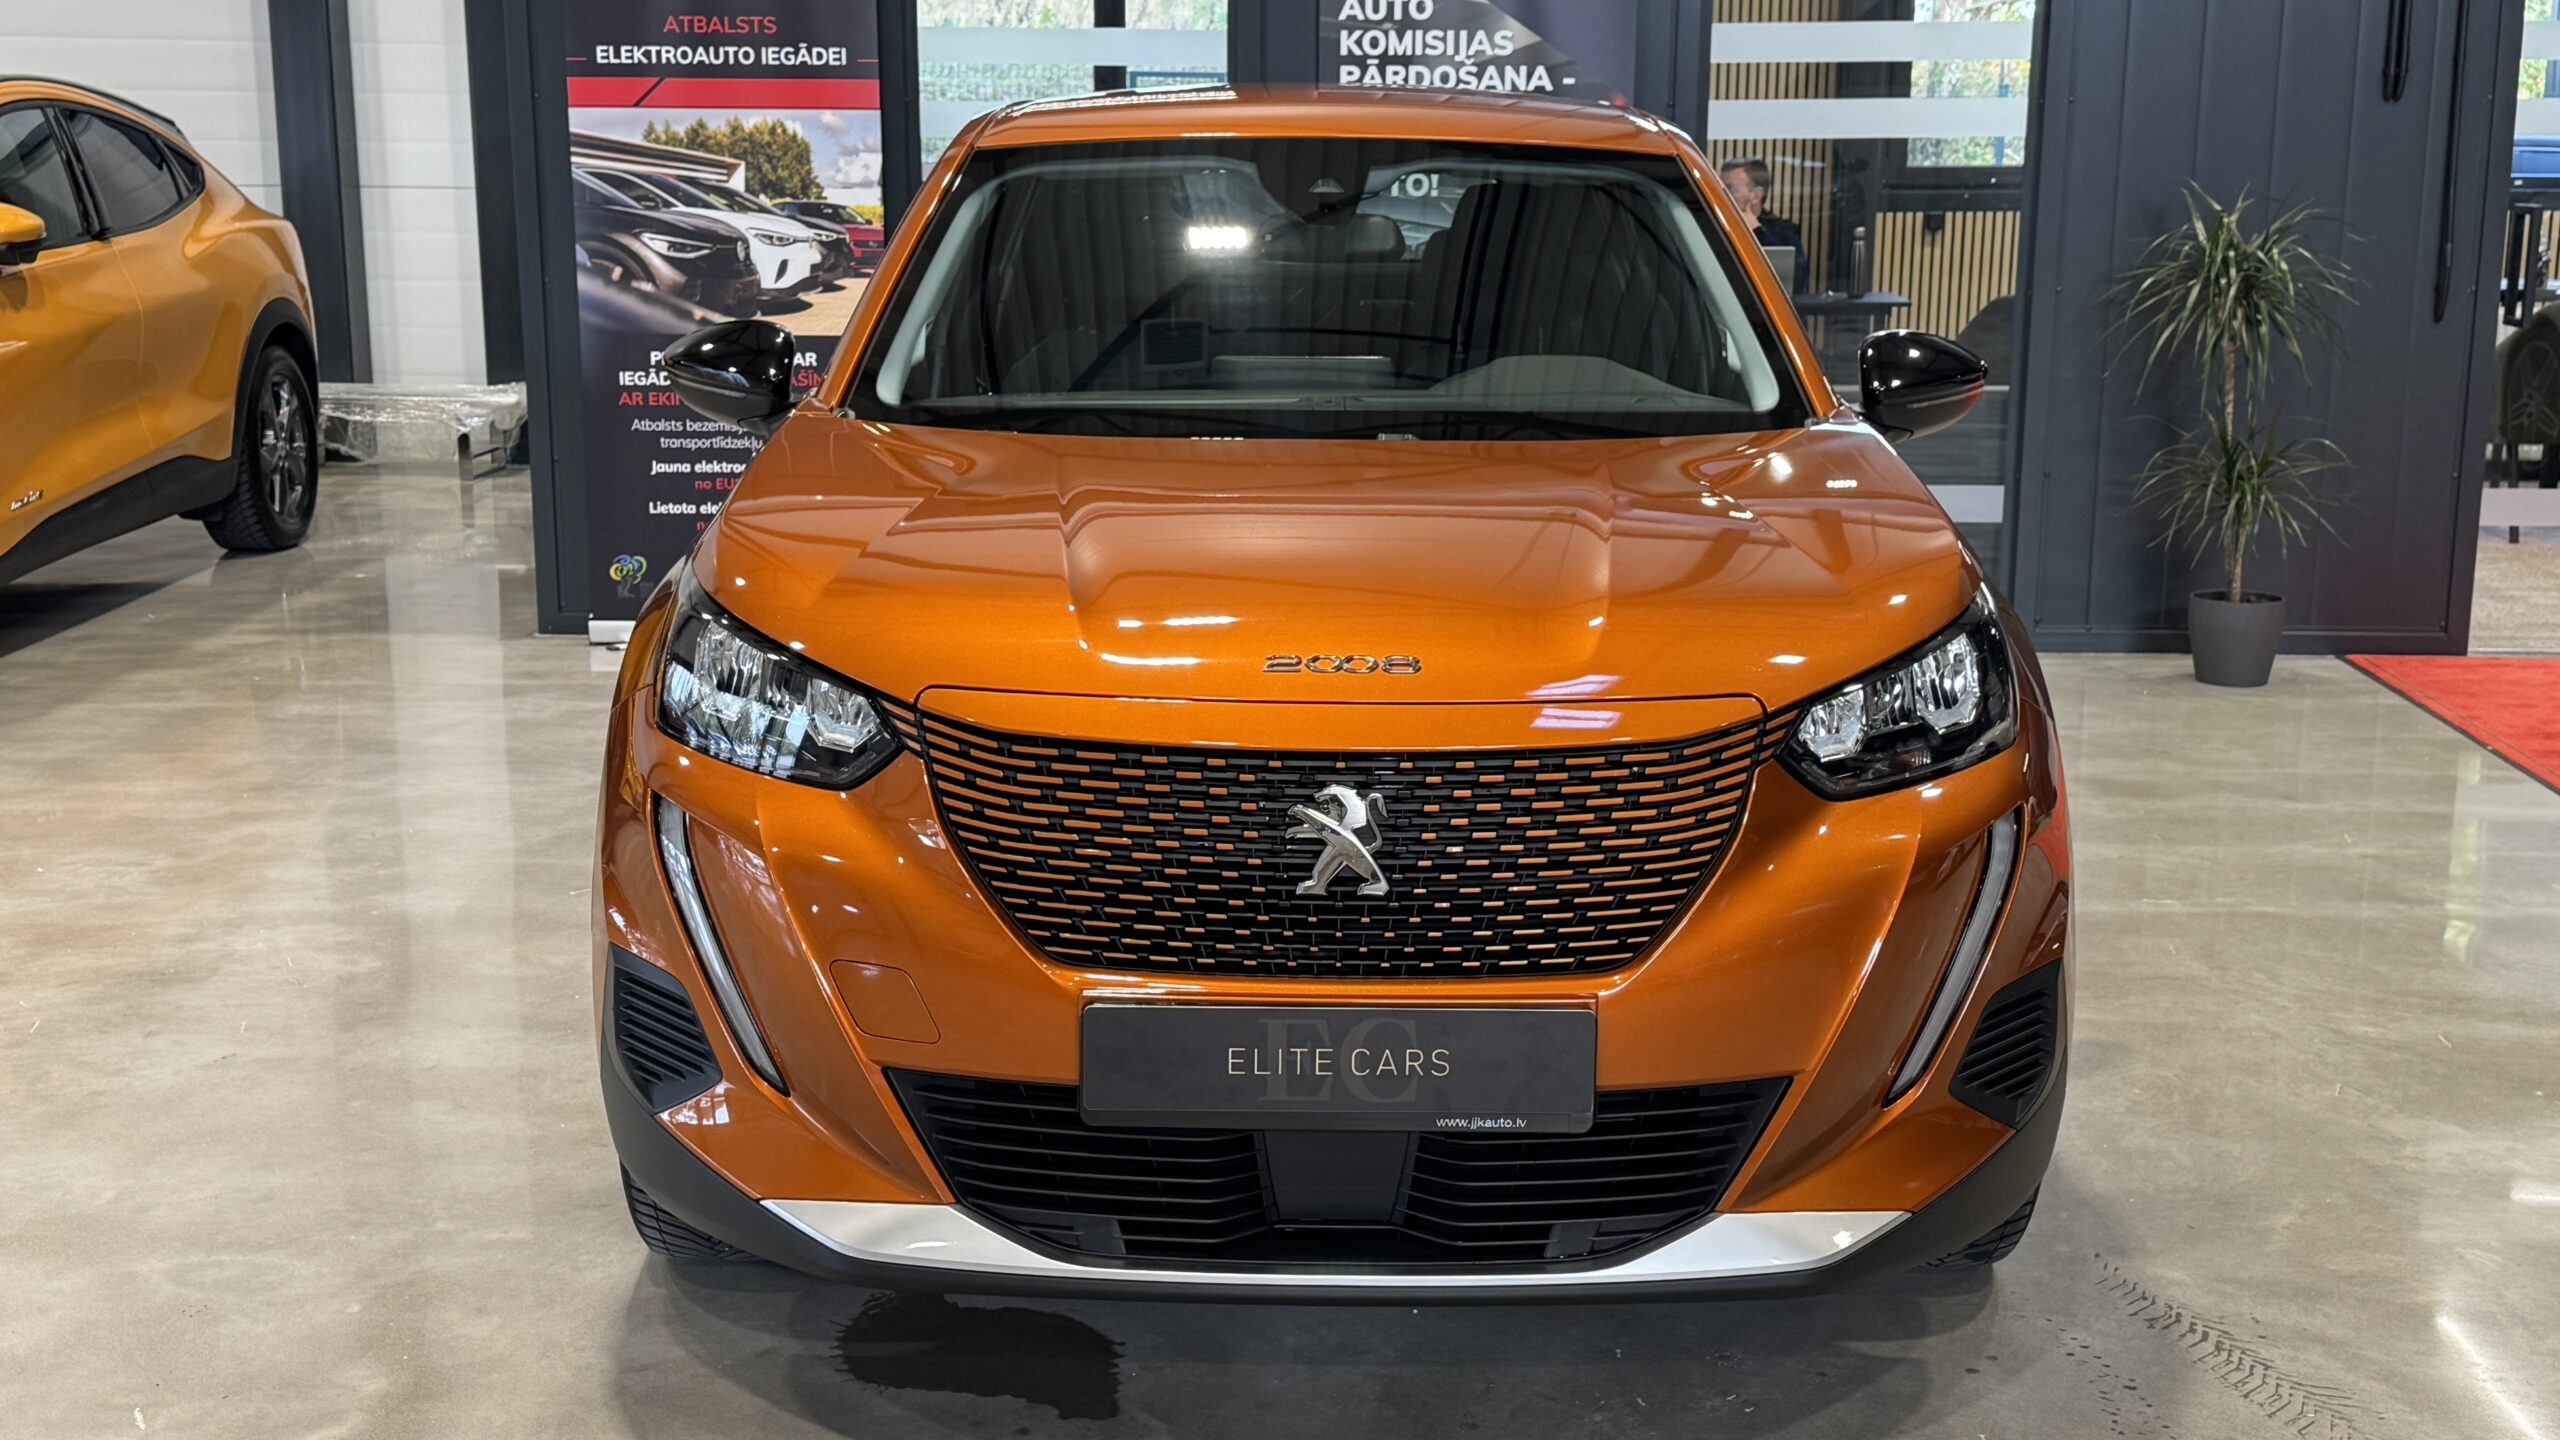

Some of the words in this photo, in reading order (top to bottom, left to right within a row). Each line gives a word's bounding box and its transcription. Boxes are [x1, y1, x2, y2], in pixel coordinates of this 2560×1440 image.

[1338, 0, 1434, 21] AUTO
[663, 16, 777, 34] ATBALSTS
[595, 45, 755, 65] ELEKTROAUTO
[761, 43, 847, 66] IEGĀDEI
[1339, 30, 1514, 61] KOMISIJAS
[1339, 58, 1554, 91] PĀRDOŠANA
[619, 392, 643, 405] AR
[631, 418, 683, 432] Atbalsts
[650, 460, 691, 475] Jauna
[695, 480, 712, 489] no
[715, 478, 740, 490] EU
[649, 501, 697, 514] Lietota
[1263, 655, 1422, 674] 2008
[1227, 1047, 1334, 1076] ELITE
[1350, 1048, 1451, 1077] CARS
[1435, 1115, 1528, 1130] www.jjkauto.lv
